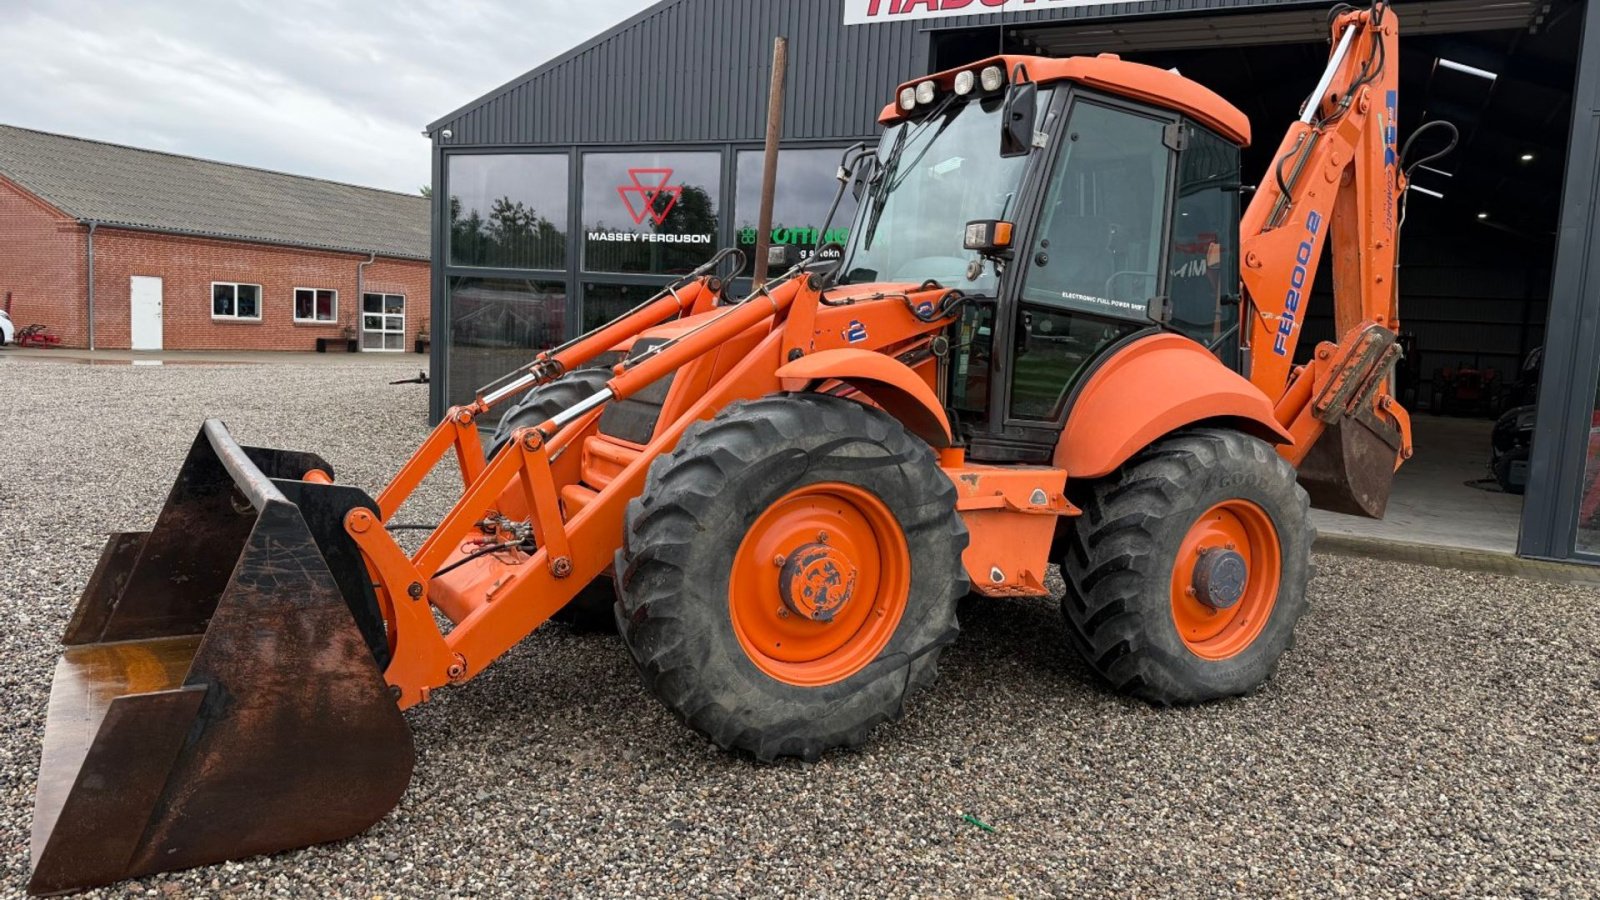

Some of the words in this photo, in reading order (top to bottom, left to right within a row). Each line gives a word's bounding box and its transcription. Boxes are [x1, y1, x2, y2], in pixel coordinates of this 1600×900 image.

[588, 232, 639, 242] MASSEY
[641, 233, 711, 243] FERGUSON
[1273, 209, 1322, 357] FB200.2
[1062, 291, 1096, 303] ELECTRONIC
[1111, 300, 1130, 308] POWER
